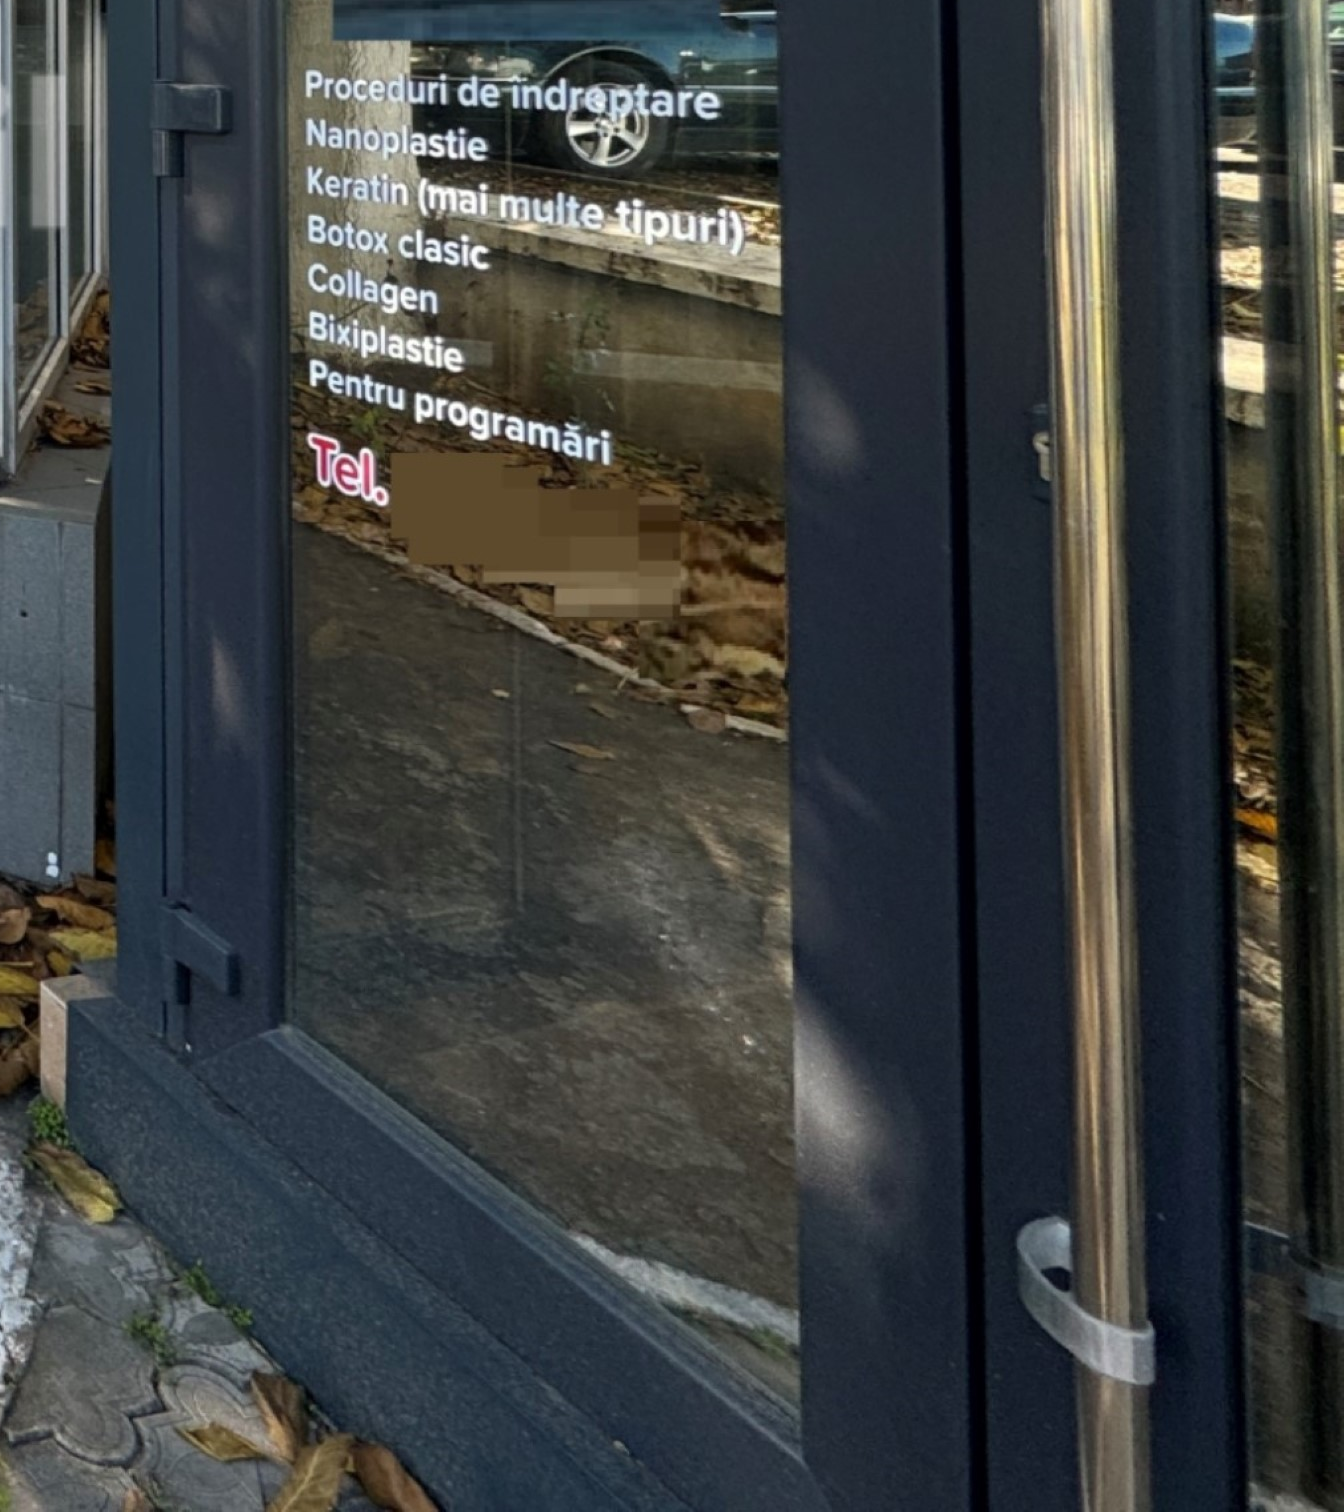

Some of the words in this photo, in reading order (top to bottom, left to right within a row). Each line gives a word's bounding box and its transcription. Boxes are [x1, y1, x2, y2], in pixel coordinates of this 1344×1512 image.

[305, 69, 448, 106] Proceduri
[457, 75, 500, 108] de
[512, 76, 722, 121] îndreptare
[305, 118, 489, 161] Nanoplastie
[306, 166, 409, 206] Keratin
[417, 177, 489, 217] (mai
[500, 191, 604, 230] multe
[615, 198, 745, 256] tipuri)
[307, 214, 389, 254] Botox
[398, 229, 491, 270] clasic
[307, 263, 439, 314] Collagen
[308, 310, 465, 373] Bixiplastie
[309, 359, 405, 411] Pentru
[414, 391, 612, 466] programări
[307, 432, 389, 506] Tel.
